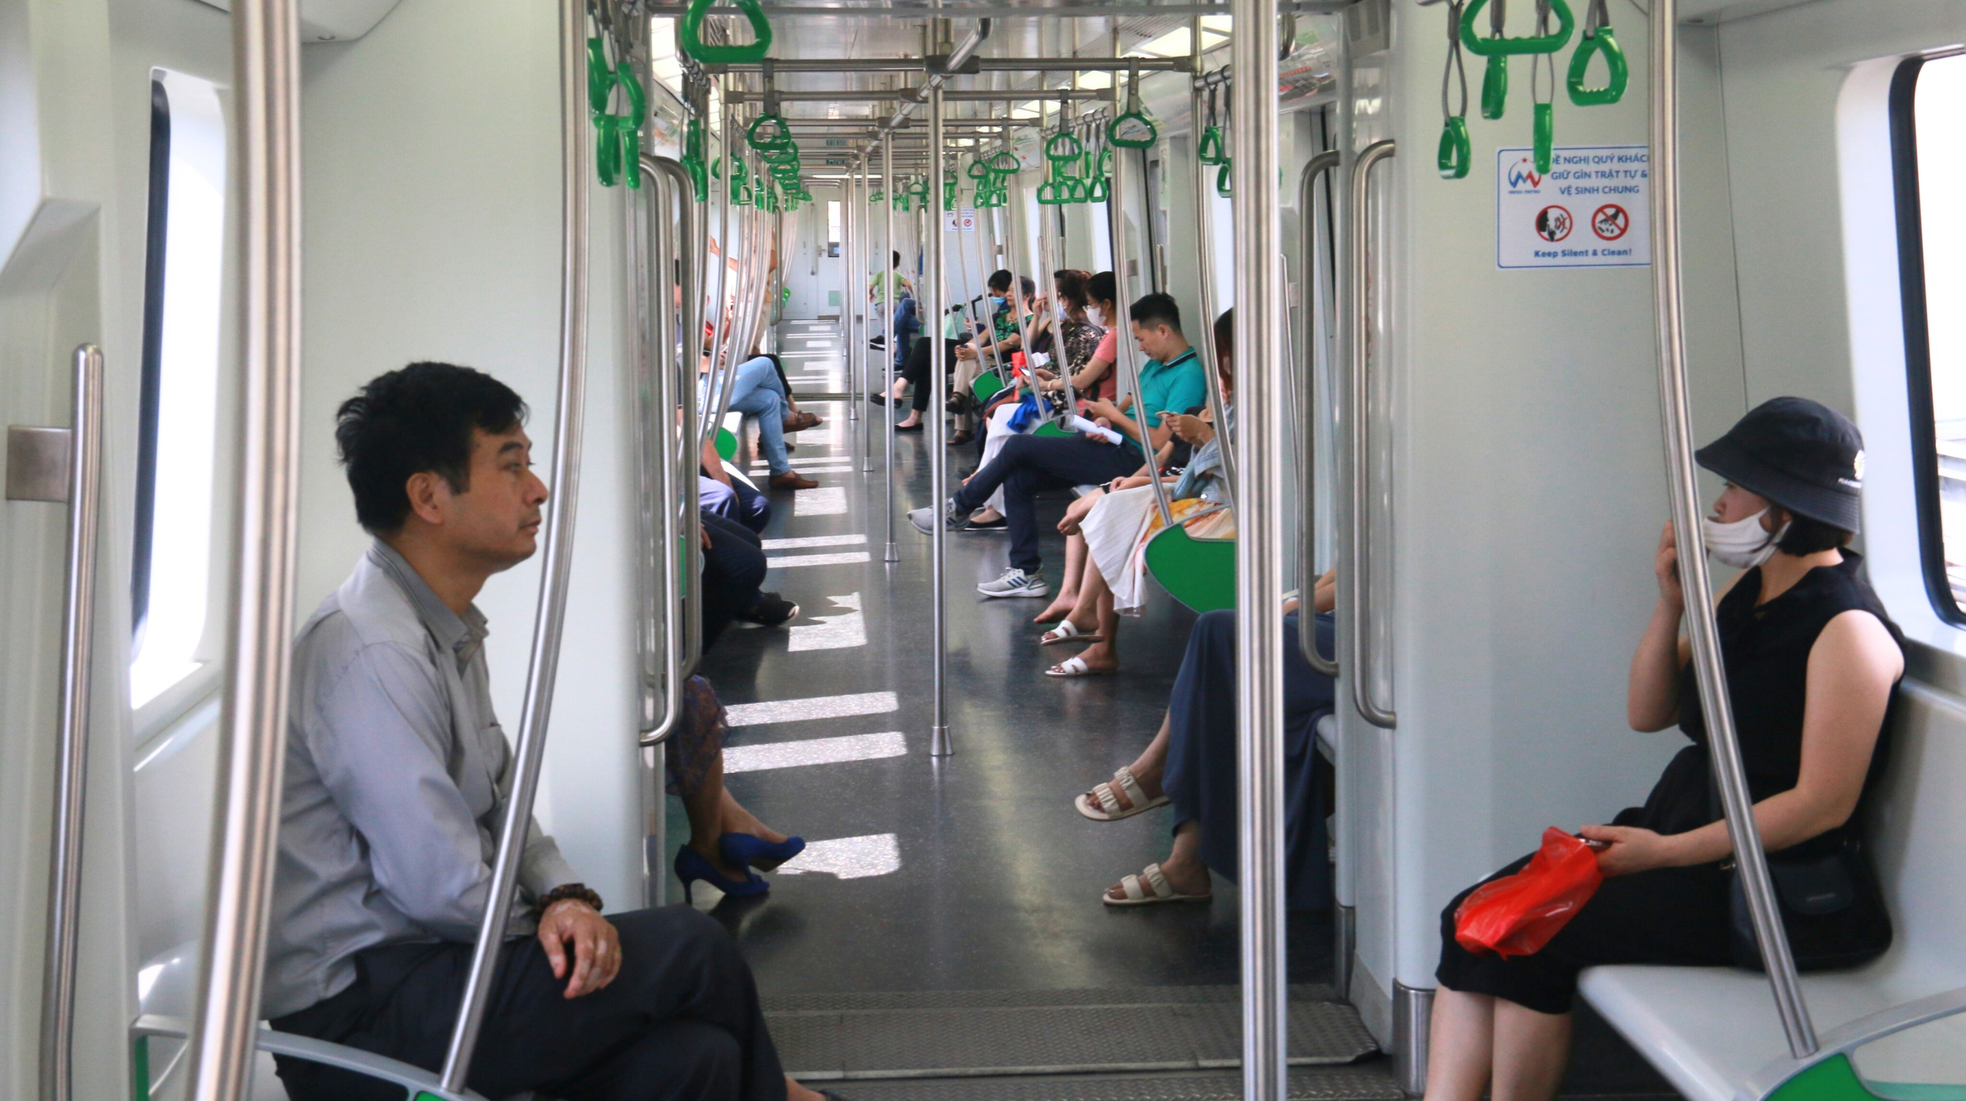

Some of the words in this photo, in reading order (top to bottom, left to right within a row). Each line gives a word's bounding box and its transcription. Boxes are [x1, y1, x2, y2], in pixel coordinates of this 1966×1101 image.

[1564, 156, 1590, 166] NGHỊ
[1592, 154, 1615, 164] QUÝ
[1551, 170, 1571, 180] GIỮ
[1574, 169, 1592, 179] GÌN
[1594, 168, 1620, 180] TRẬT
[1623, 170, 1638, 180] TỰ
[1640, 170, 1648, 178] &
[1559, 184, 1573, 196] VỆ
[1575, 186, 1600, 195] SINH
[1602, 185, 1640, 194] CHUNG
[1534, 250, 1558, 259] Keep
[1561, 249, 1589, 257] Silent
[1601, 248, 1632, 256] Clean!
